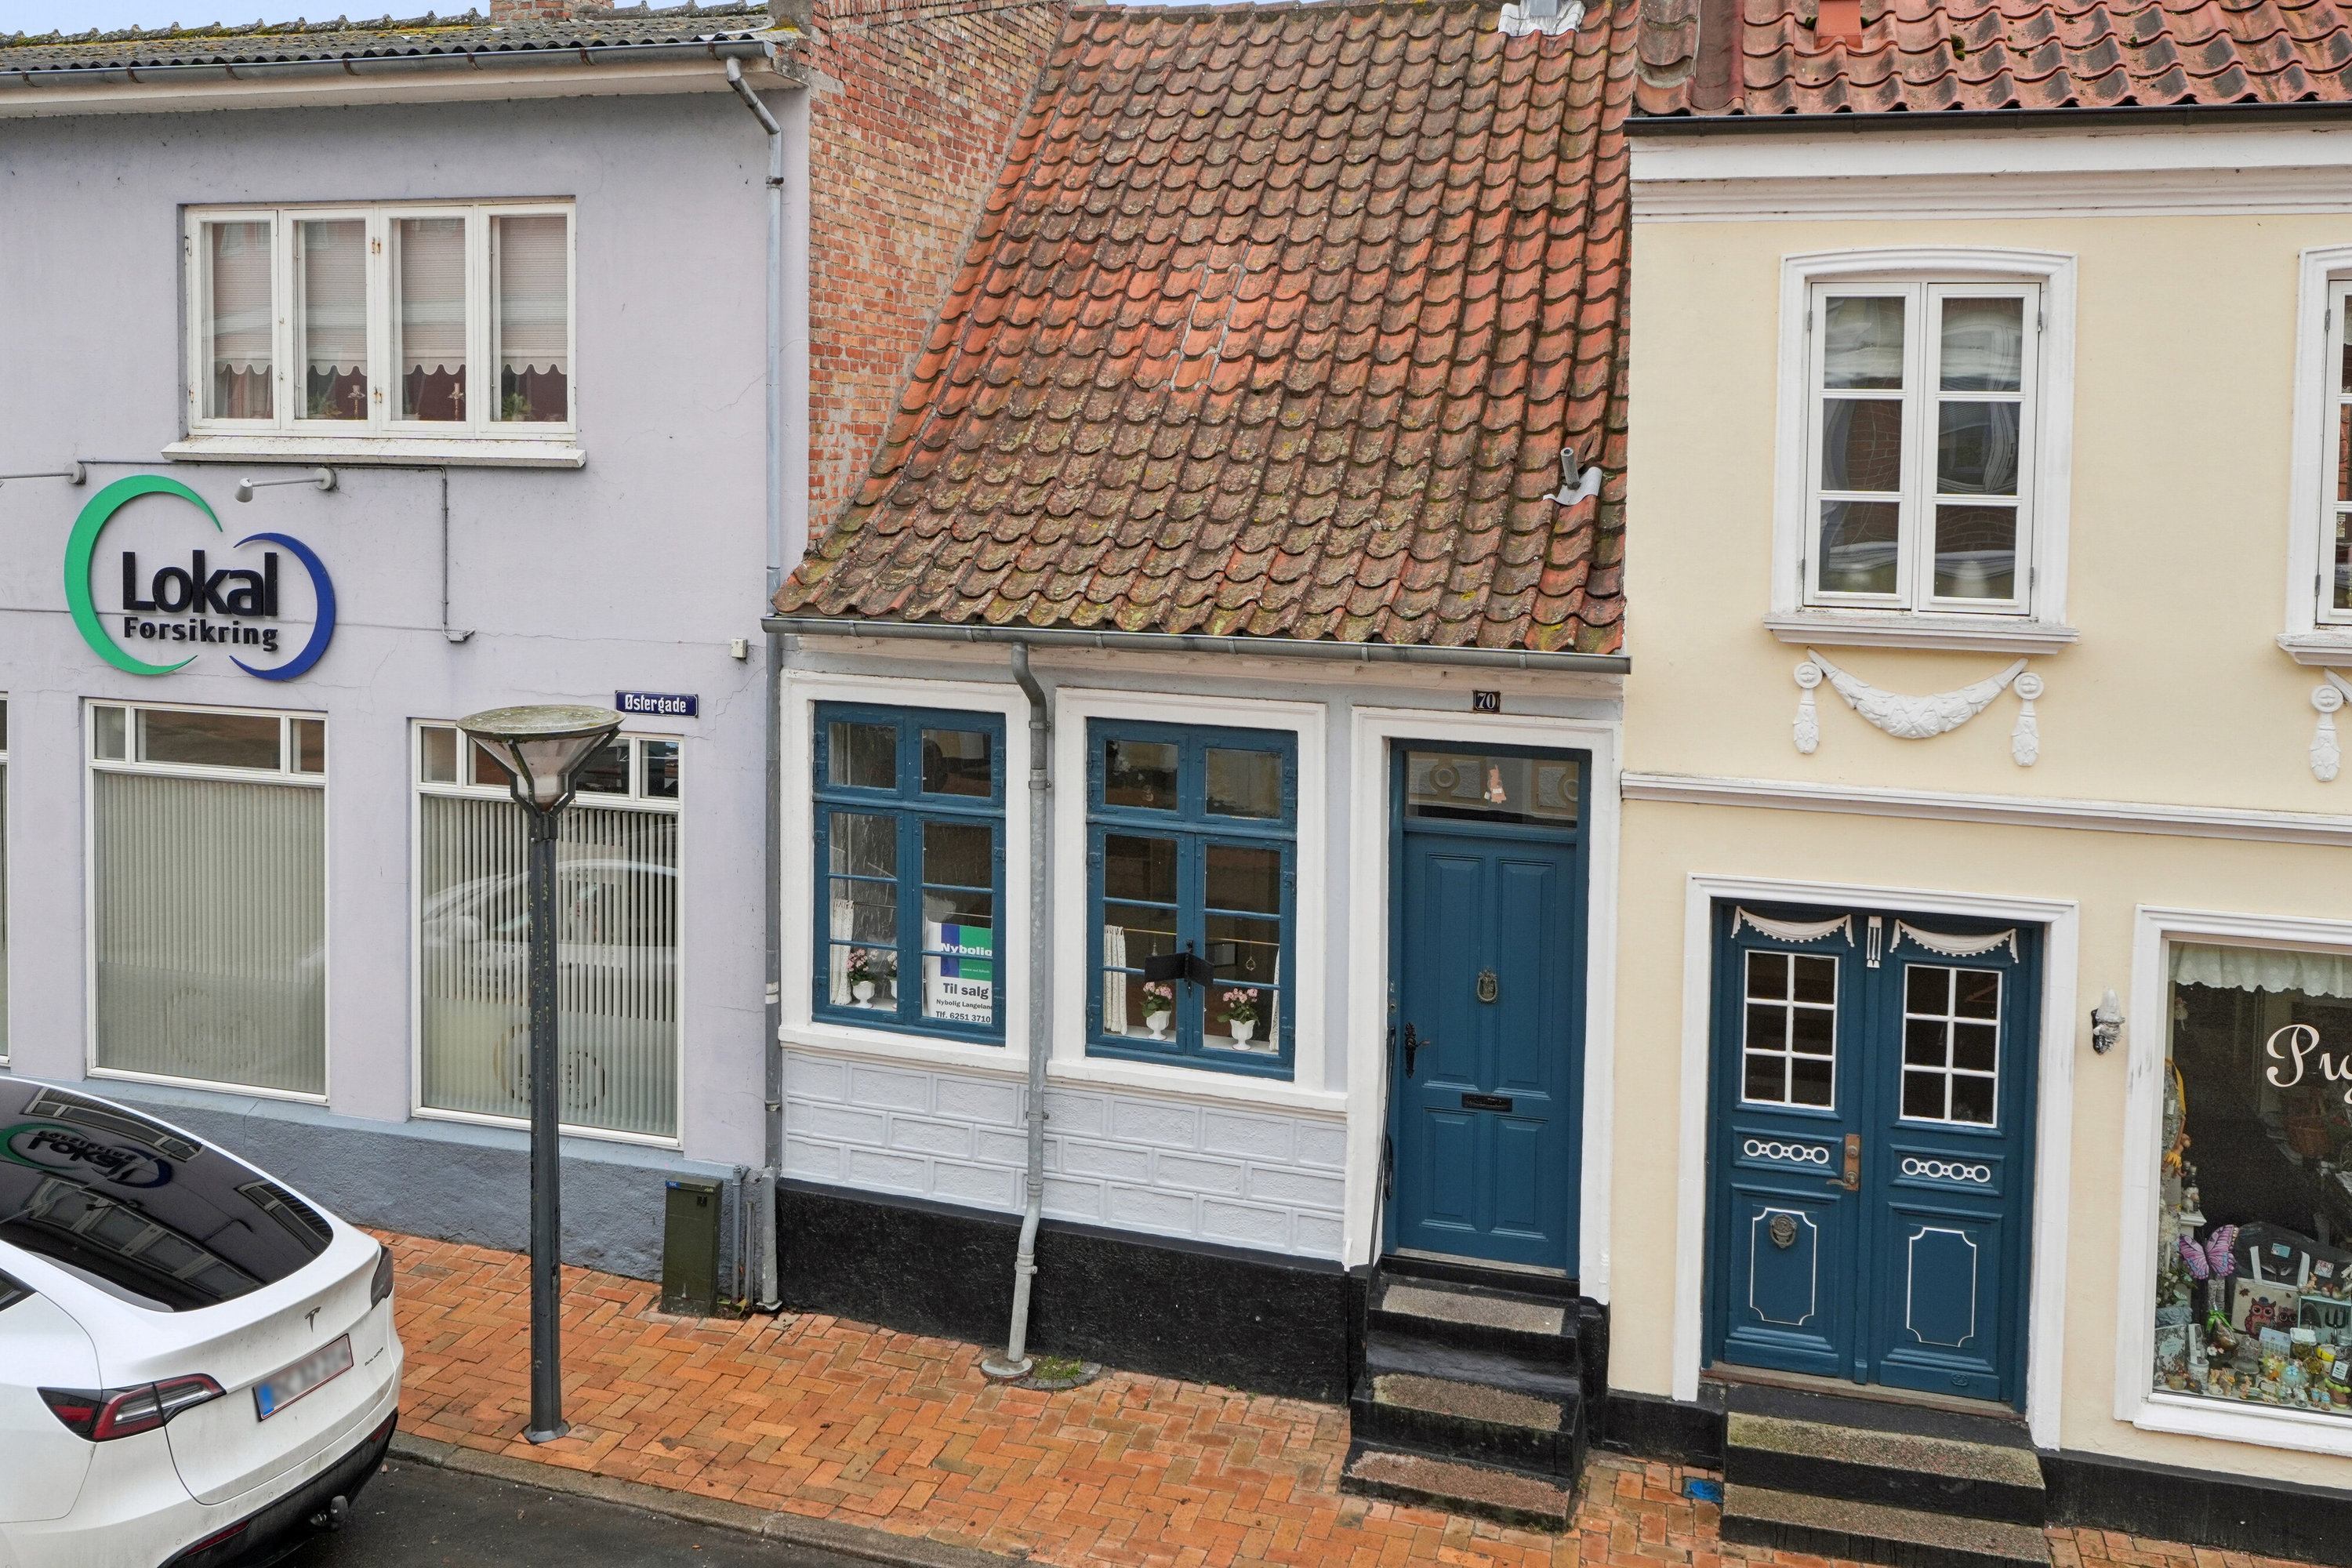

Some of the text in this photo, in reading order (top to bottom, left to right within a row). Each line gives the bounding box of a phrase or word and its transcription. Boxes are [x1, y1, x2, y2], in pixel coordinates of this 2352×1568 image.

[122, 550, 278, 616] Lokal
[124, 617, 278, 652] Forsikring
[625, 694, 687, 713] Østergade
[1478, 692, 1496, 709] 70
[943, 982, 989, 1000] Til salg
[936, 999, 961, 1008] Nybolig
[949, 1012, 970, 1021] 6251
[971, 1014, 991, 1023] 3710
